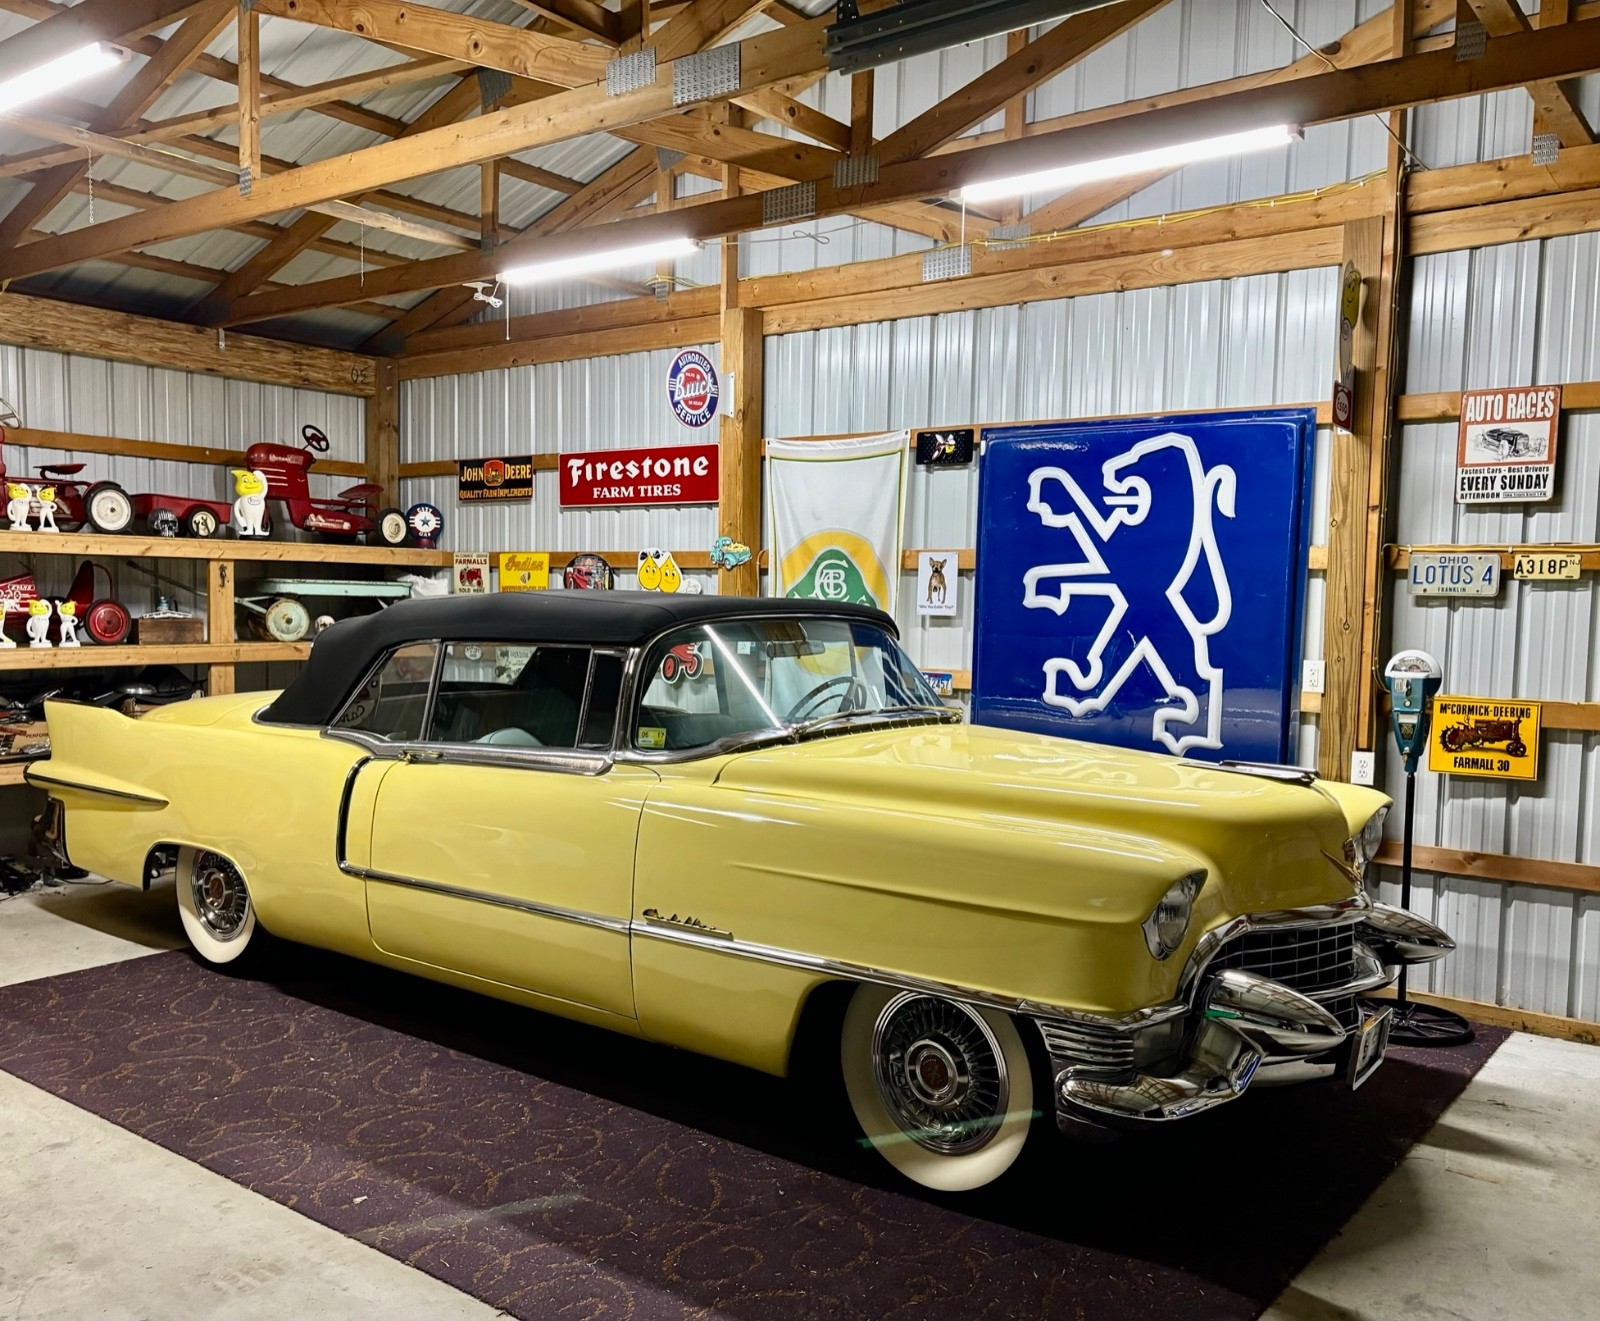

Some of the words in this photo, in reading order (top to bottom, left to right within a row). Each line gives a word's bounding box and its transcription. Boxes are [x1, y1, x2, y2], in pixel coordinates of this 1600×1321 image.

[678, 353, 710, 372] AUTHORIZED
[673, 371, 715, 402] Buick
[676, 404, 711, 425] SERVICE
[1466, 394, 1504, 422] AUTO
[1506, 390, 1555, 420] RACES
[461, 466, 484, 482] JOHN
[504, 463, 532, 480] DEERE
[567, 456, 709, 487] Firestone
[1507, 466, 1523, 474] Best
[1524, 465, 1550, 473] Drivers
[593, 486, 634, 498] FARM
[638, 484, 681, 497] TIRES
[1460, 475, 1497, 491] EVERY
[1500, 473, 1549, 490] SUNDAY
[505, 554, 544, 572] Indian
[1439, 556, 1469, 565] OHIO
[1515, 559, 1568, 575] A318P
[1413, 565, 1474, 585] LOTUS
[1482, 565, 1493, 585] 4
[1453, 756, 1495, 771] FARMALL
[1497, 759, 1510, 772] 30
